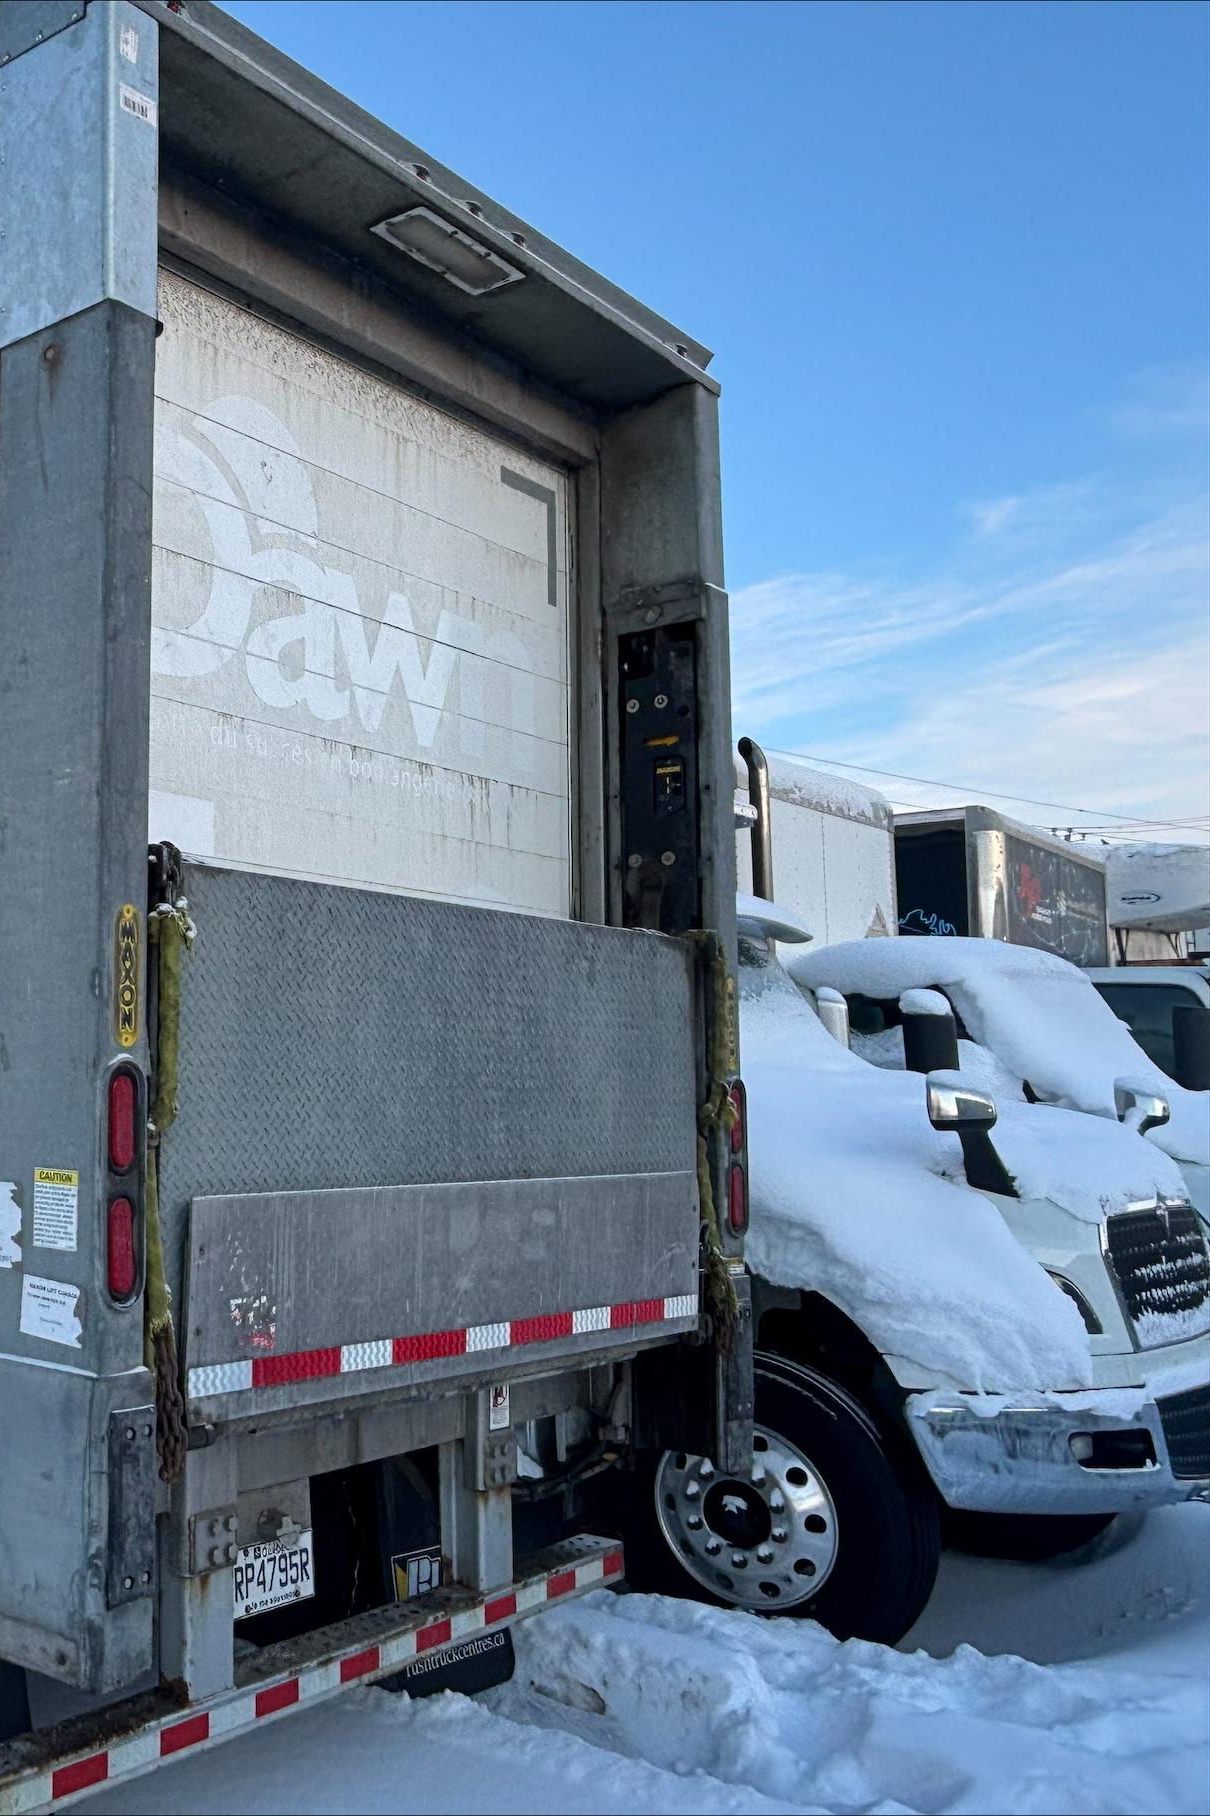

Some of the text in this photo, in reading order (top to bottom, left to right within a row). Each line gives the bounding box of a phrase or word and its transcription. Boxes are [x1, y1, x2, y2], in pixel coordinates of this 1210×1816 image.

[118, 920, 138, 1032] MAXON
[39, 1170, 73, 1184] CAUTION
[233, 1547, 310, 1604] RP4795R
